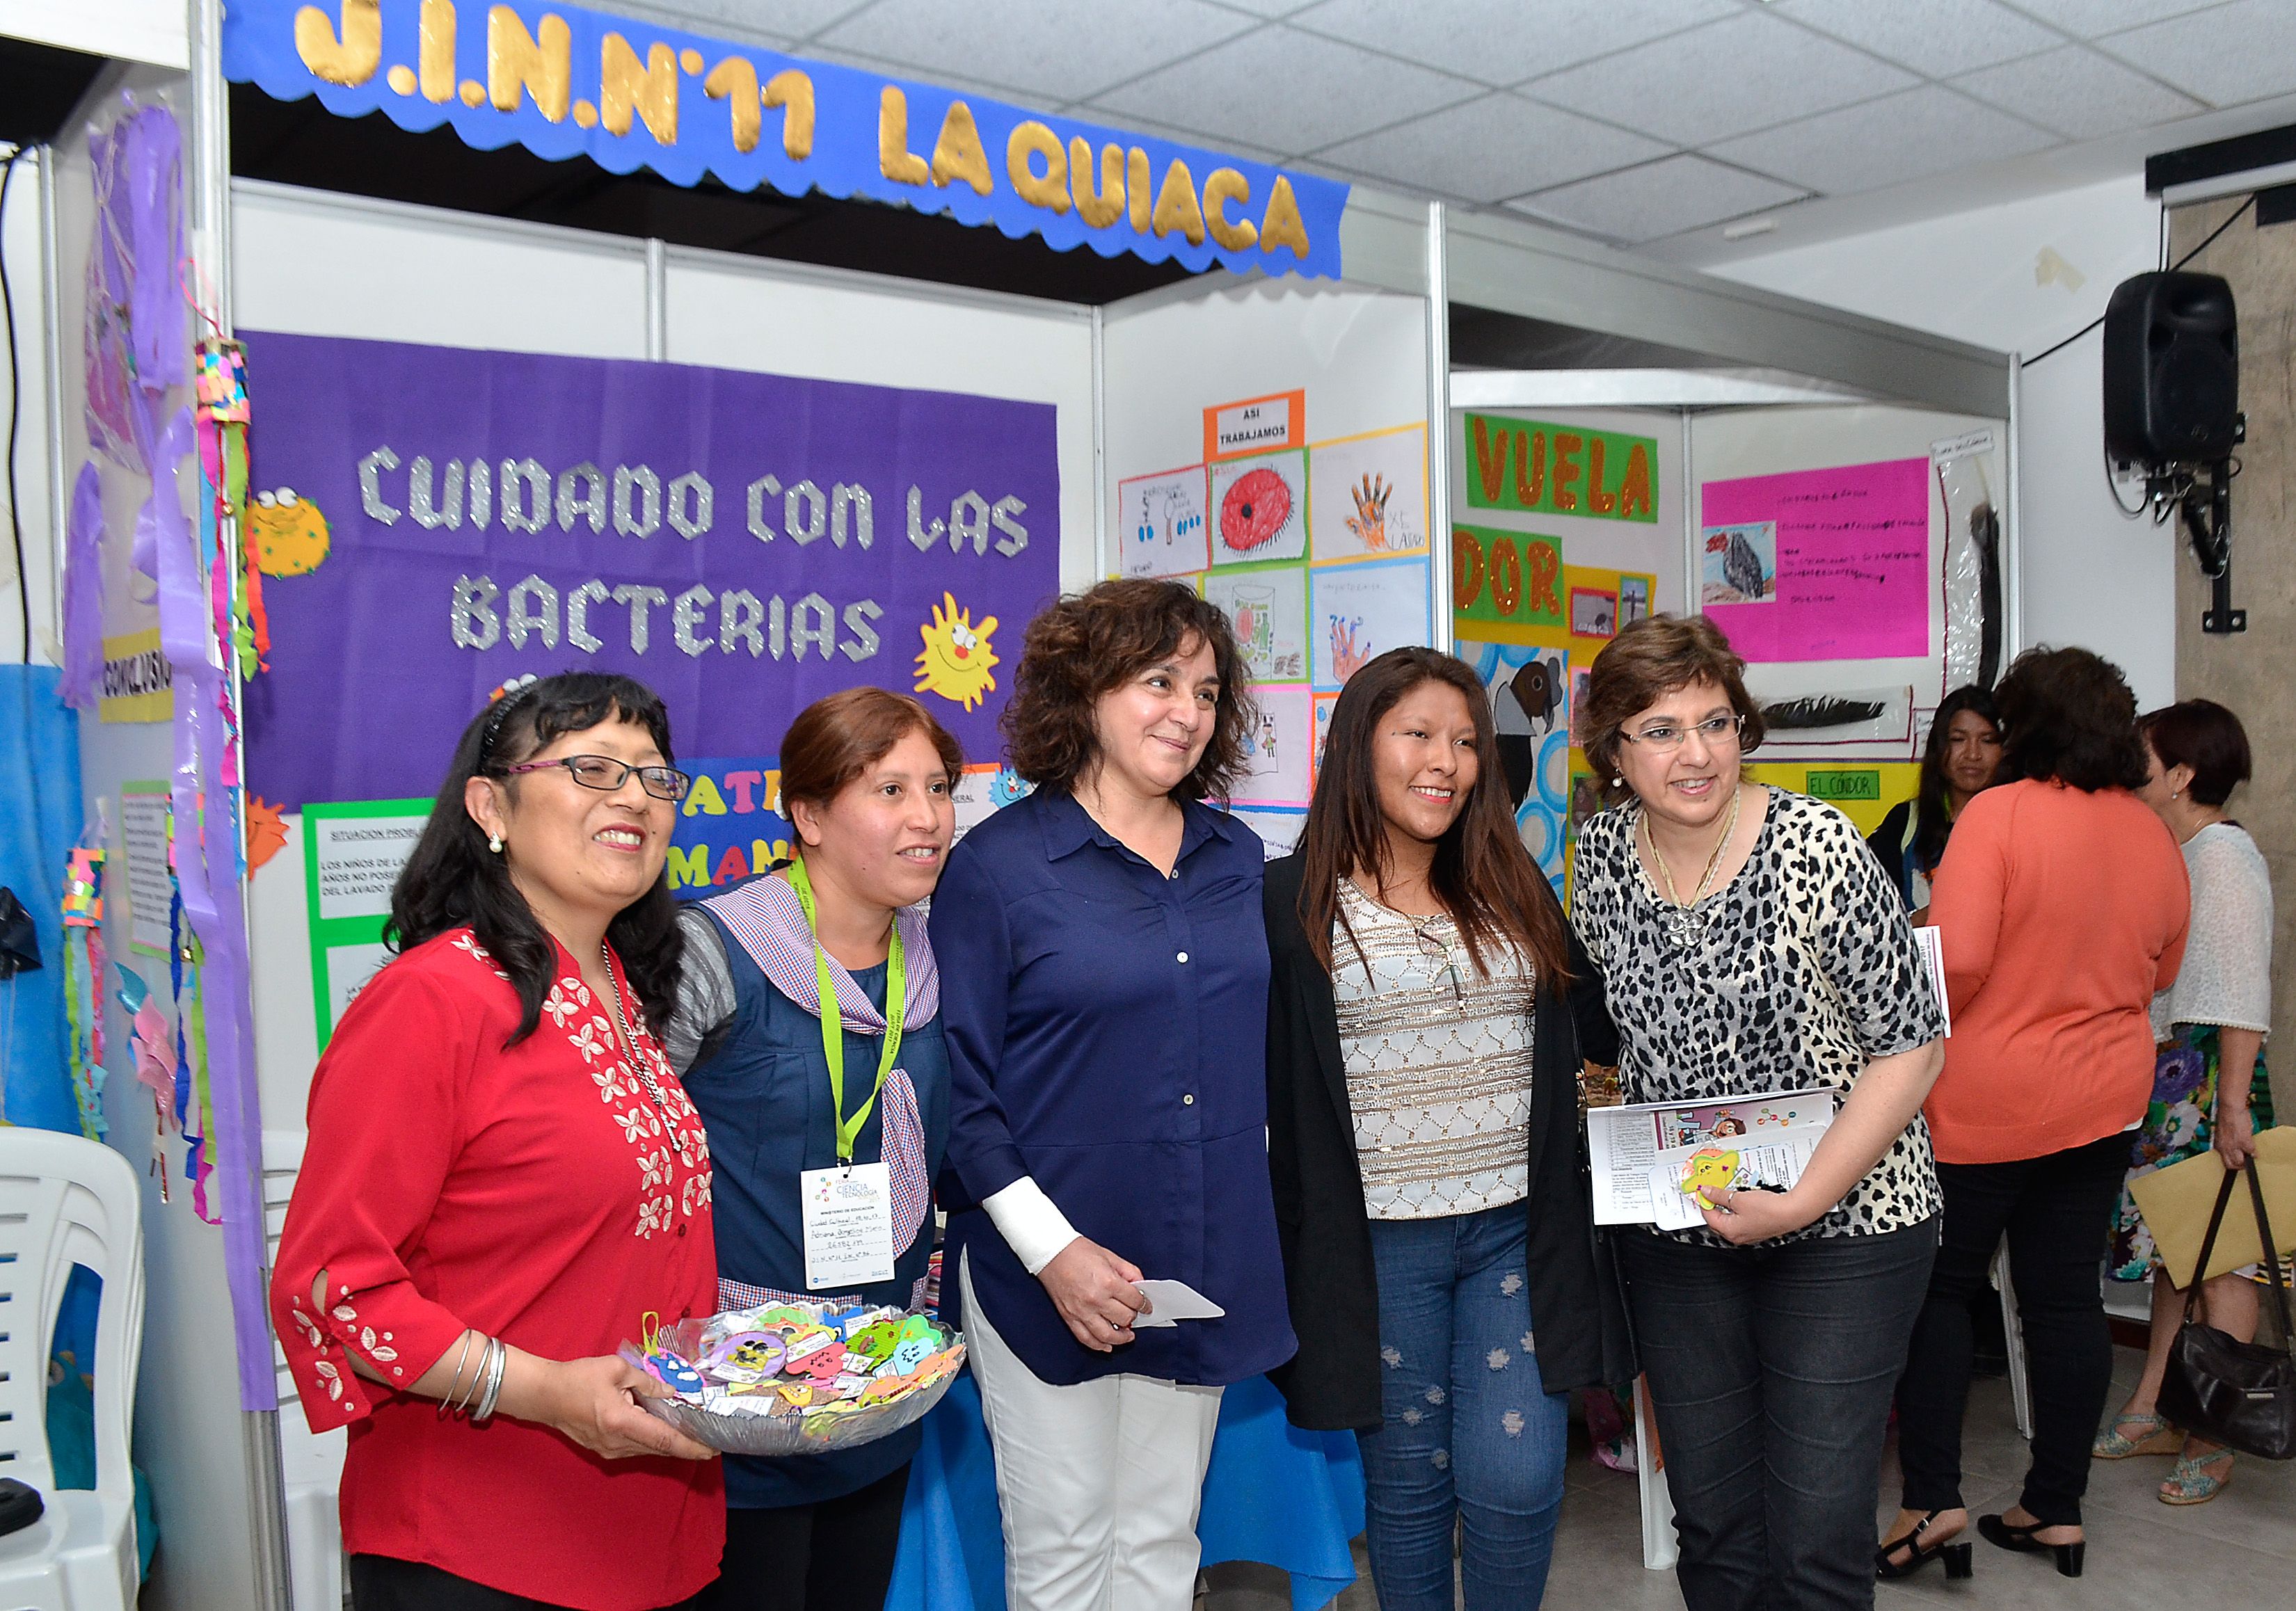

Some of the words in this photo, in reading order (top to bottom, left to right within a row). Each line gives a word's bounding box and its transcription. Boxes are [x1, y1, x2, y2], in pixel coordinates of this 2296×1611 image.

[879, 84, 994, 196] LA
[1006, 120, 1310, 260] QUIACA
[1220, 425, 1285, 444] TRABAJAMOS
[1243, 408, 1259, 419] ASI
[358, 444, 714, 540] CUIDADO
[747, 473, 874, 550] CON
[907, 483, 1028, 558] LAS
[1473, 415, 1651, 518] VUELA
[1453, 530, 1561, 616] DOR
[450, 574, 884, 662] BACTERIAS
[344, 884, 386, 895] LAVADO
